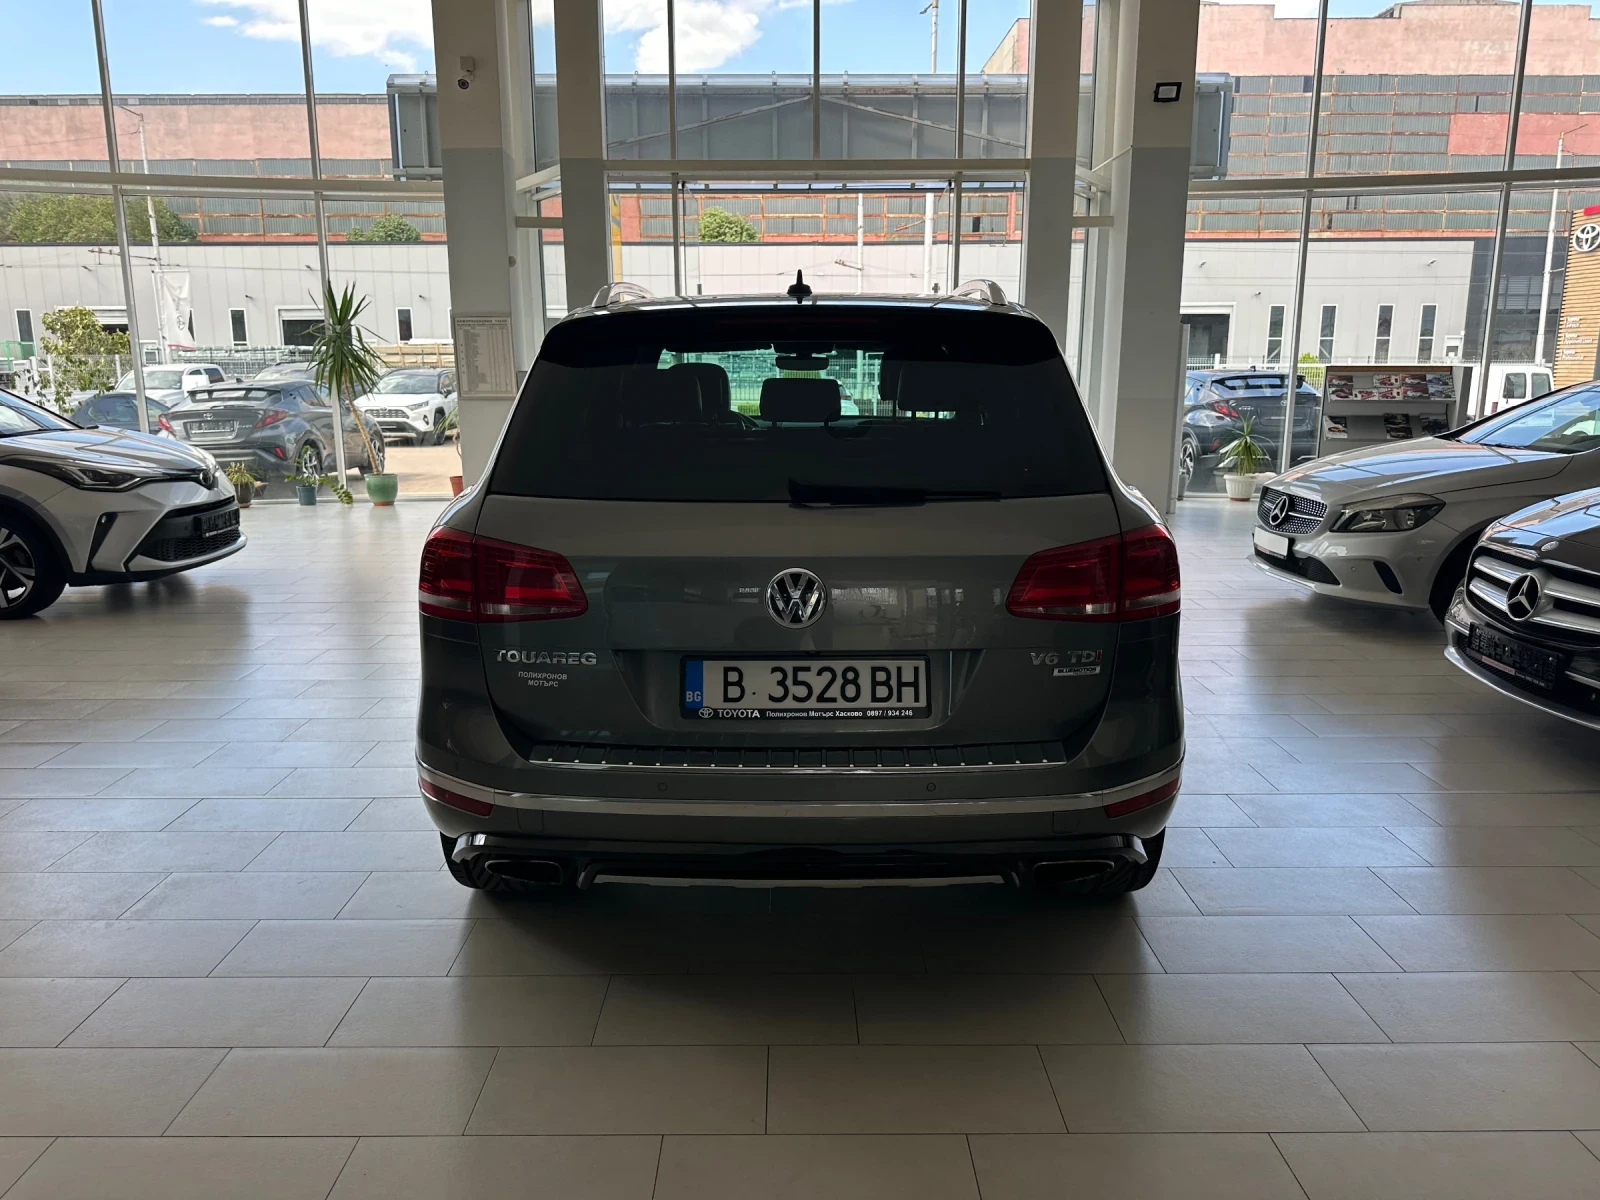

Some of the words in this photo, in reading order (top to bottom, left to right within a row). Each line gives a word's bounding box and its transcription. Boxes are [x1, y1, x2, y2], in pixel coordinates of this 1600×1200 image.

[496, 650, 597, 666] TOUAREG
[1030, 652, 1060, 666] V6
[1067, 649, 1103, 664] TDI
[518, 671, 567, 680] ПОЛИХРОНОВ
[768, 666, 861, 704] 3528
[870, 666, 920, 703] BH
[686, 691, 702, 702] BG
[717, 709, 761, 718] TOYOTA
[766, 710, 808, 718] Полихронов
[808, 710, 834, 718] Мотърс
[835, 710, 863, 718] Хасково
[887, 709, 900, 717] 934
[901, 709, 913, 717] 246
